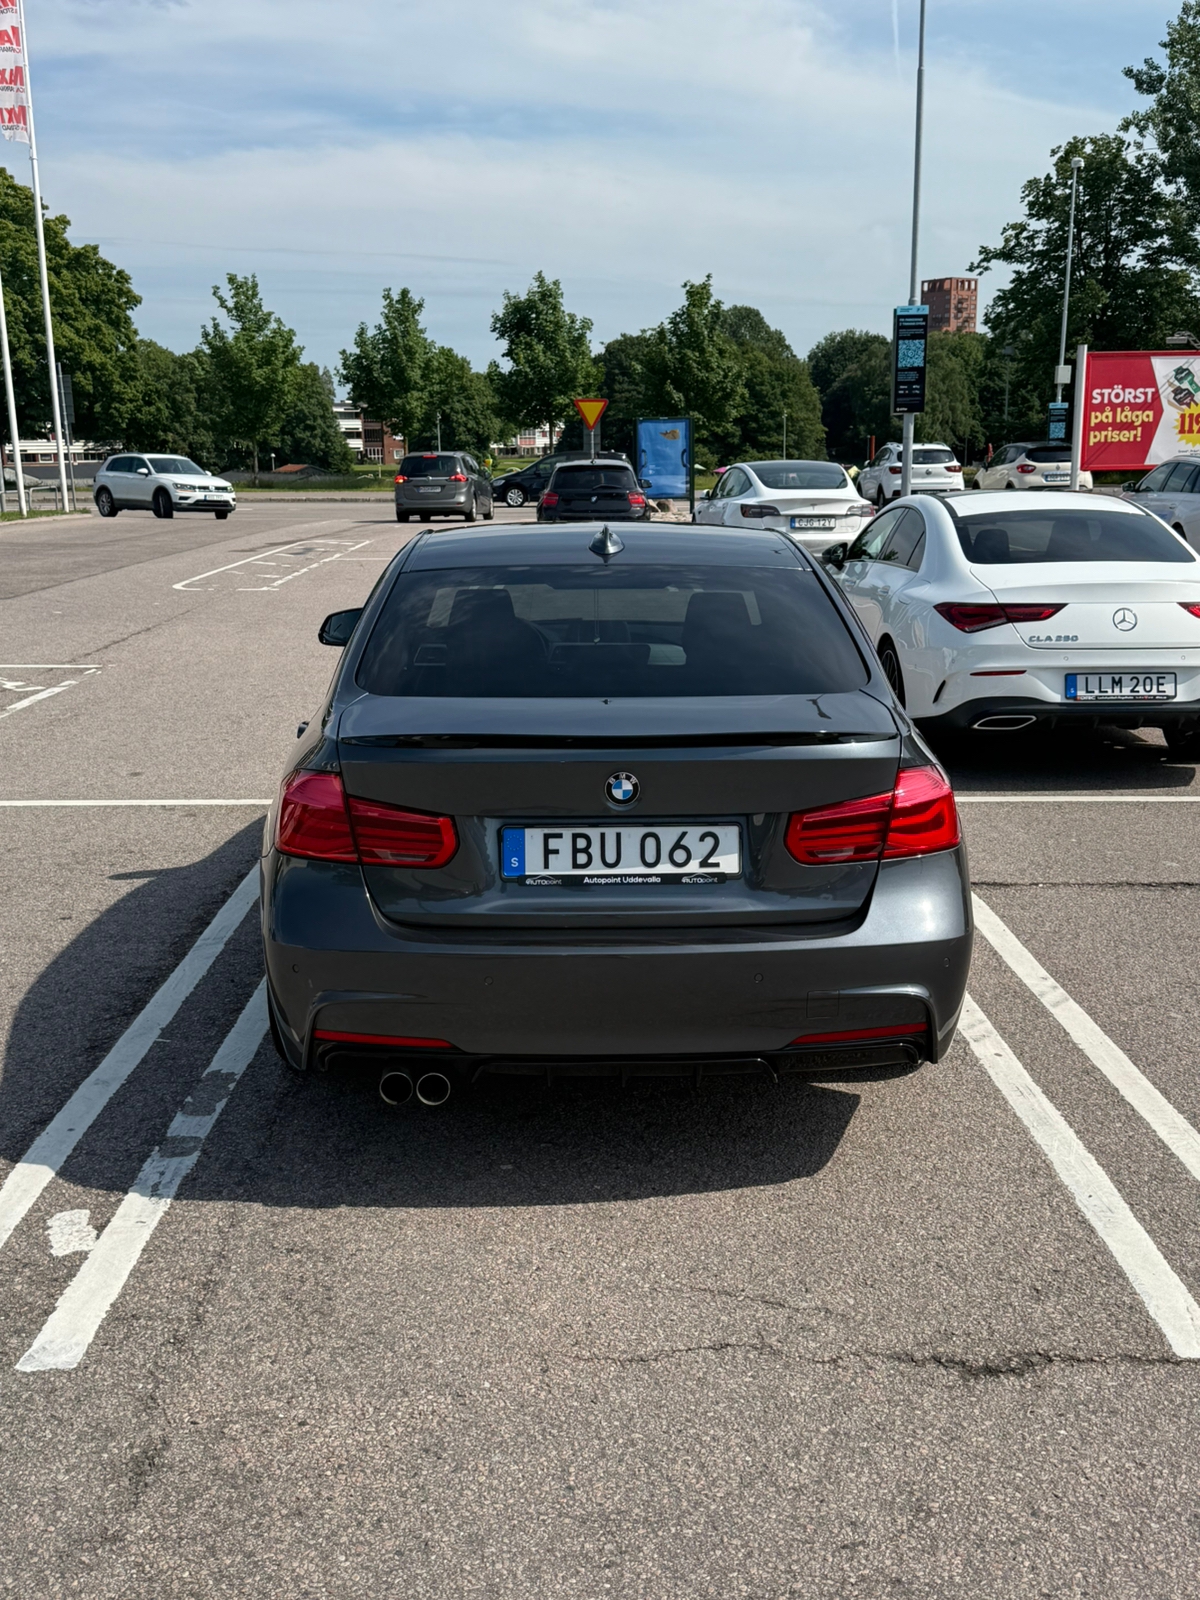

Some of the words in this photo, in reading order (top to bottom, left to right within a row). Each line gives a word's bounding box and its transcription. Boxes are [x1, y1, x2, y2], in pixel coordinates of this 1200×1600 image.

[1091, 384, 1155, 404] STÖRST
[1090, 406, 1113, 427] på
[1116, 406, 1154, 426] låga
[1089, 427, 1142, 446] priser!
[1028, 635, 1054, 643] CLA
[1084, 676, 1123, 694] LLM
[1129, 676, 1167, 694] 20E
[543, 832, 622, 870] FBU
[640, 831, 721, 869] 062
[510, 857, 519, 867] S
[583, 876, 621, 885] Autopoint
[622, 876, 661, 884] Uddevalla
